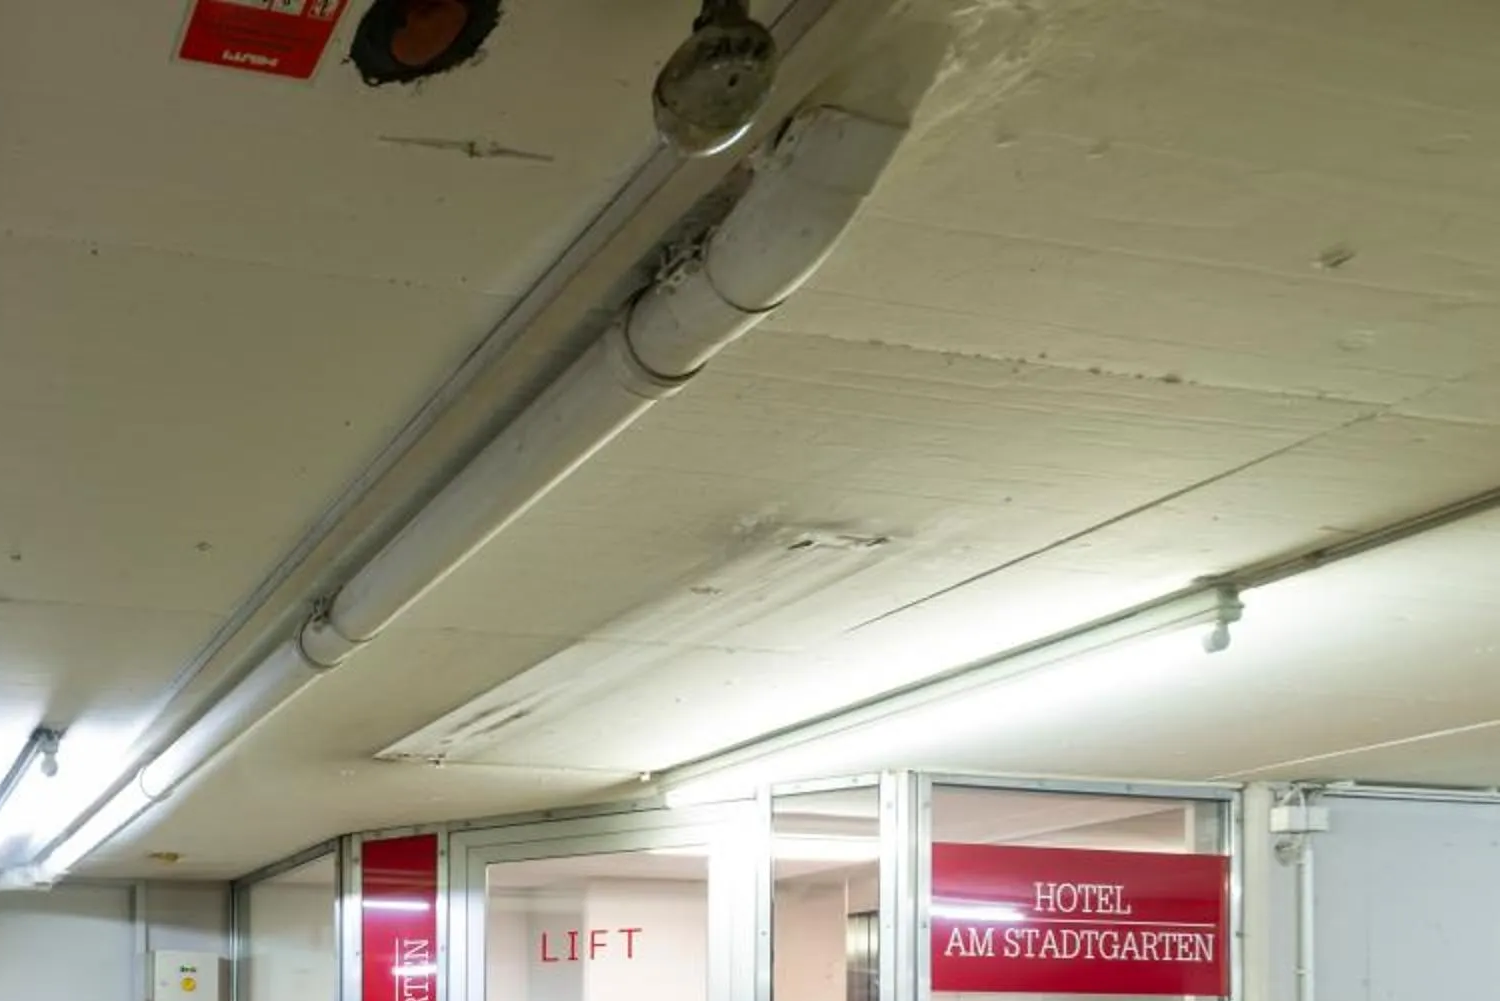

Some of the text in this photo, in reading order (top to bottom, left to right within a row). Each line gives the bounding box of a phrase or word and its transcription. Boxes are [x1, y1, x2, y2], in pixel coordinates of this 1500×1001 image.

[1033, 882, 1131, 915] HOTEL
[541, 928, 642, 961] LIFT
[943, 927, 1214, 962] AM STADTGARTEN
